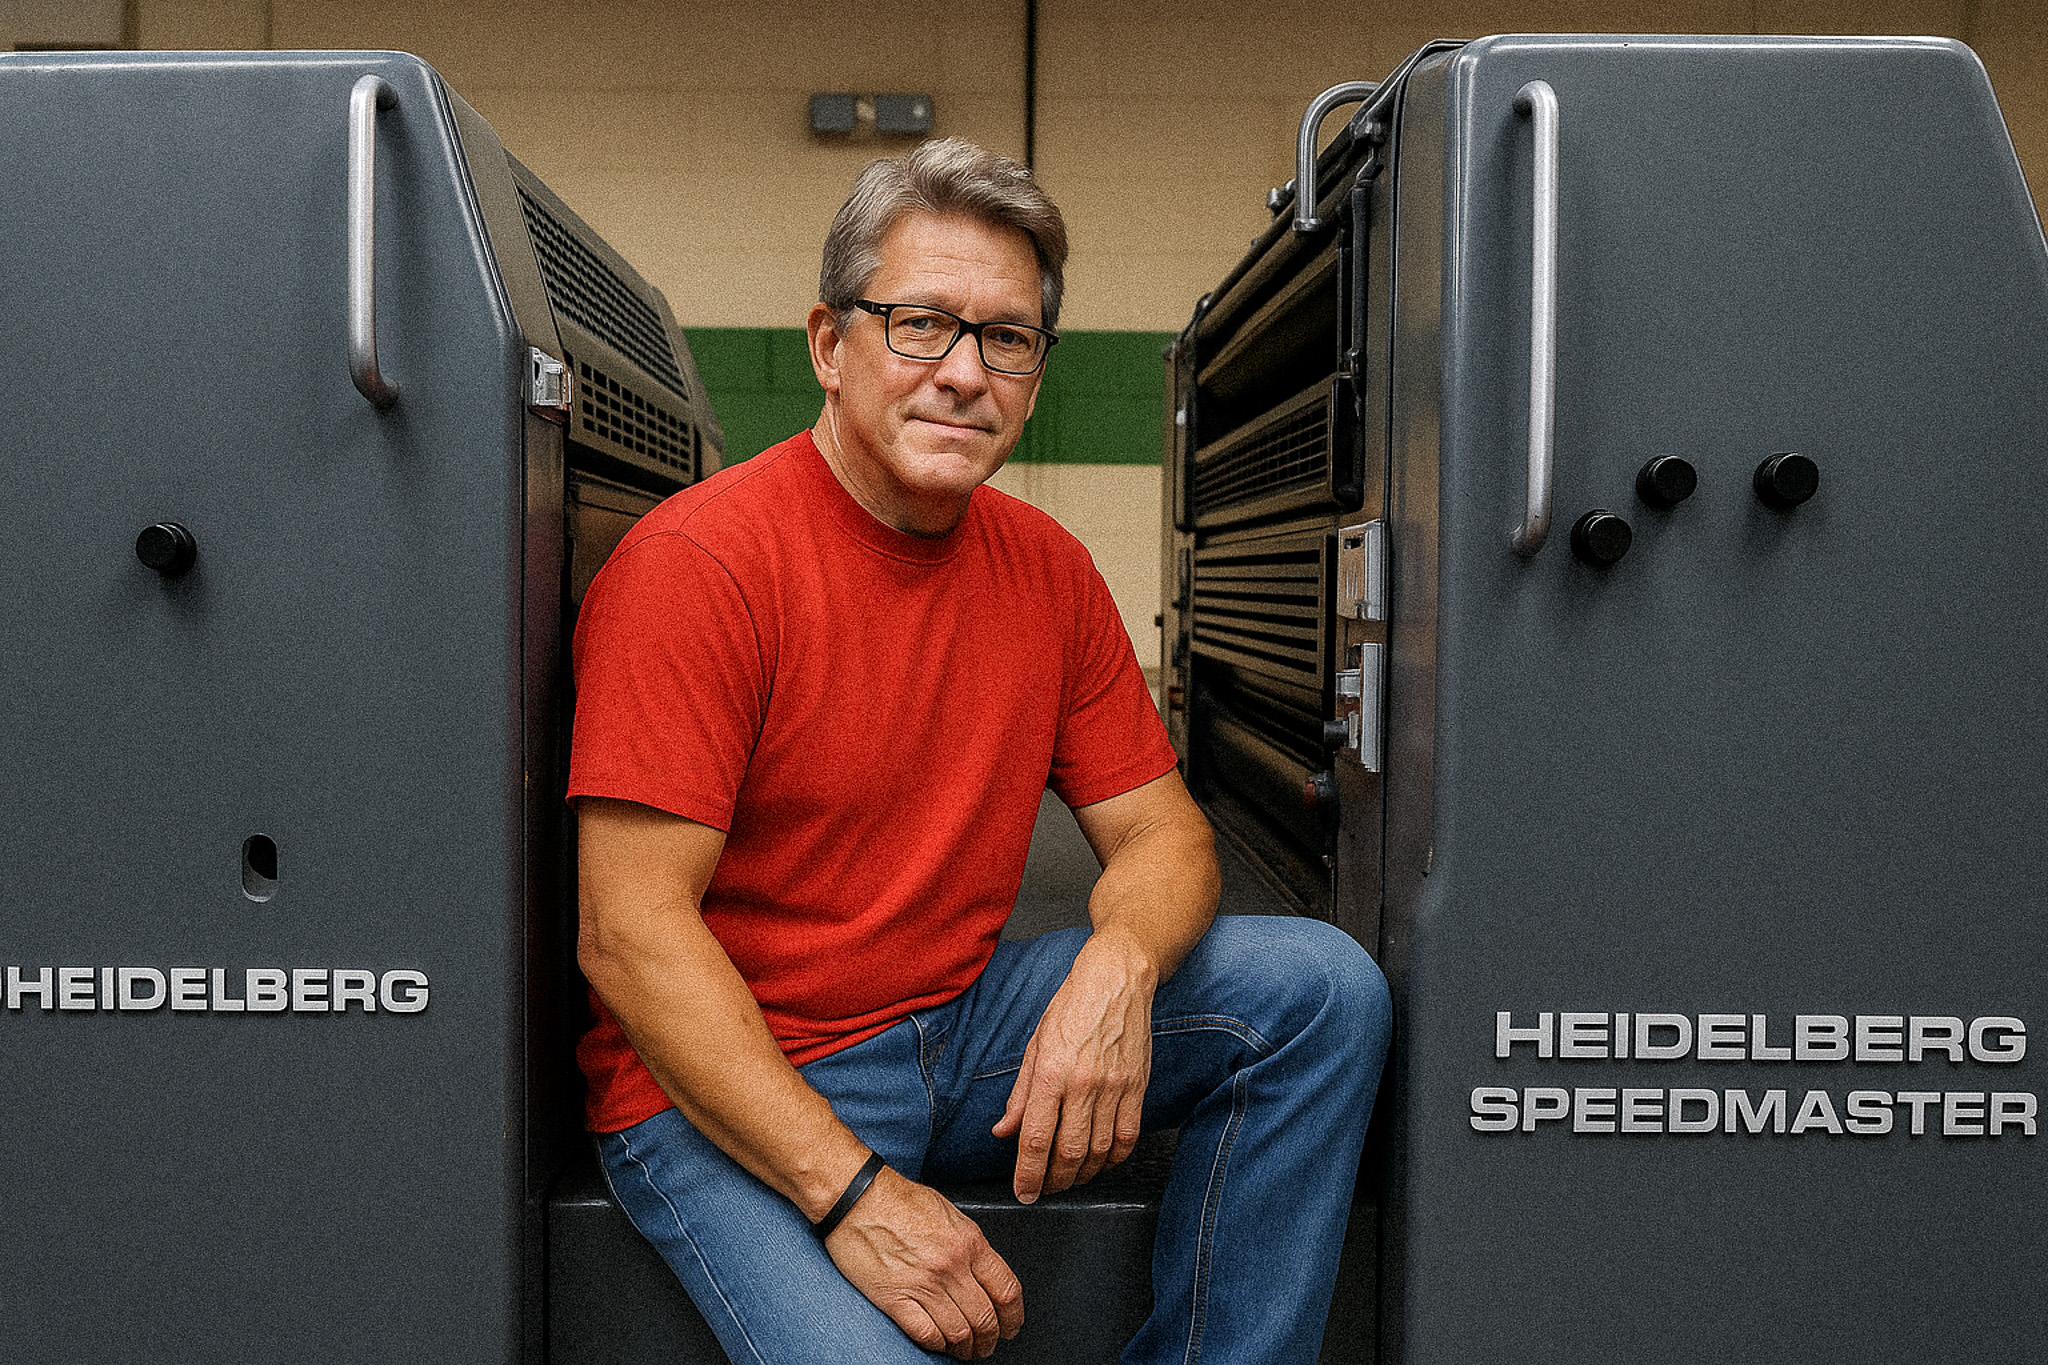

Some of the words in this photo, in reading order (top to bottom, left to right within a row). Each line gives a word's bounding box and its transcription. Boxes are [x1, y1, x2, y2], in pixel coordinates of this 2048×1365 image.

[7, 966, 430, 1013] HEIDELBERG
[1496, 1011, 2028, 1062] HEIDELBERG
[1470, 1086, 2038, 1136] SPEEDMASTER
